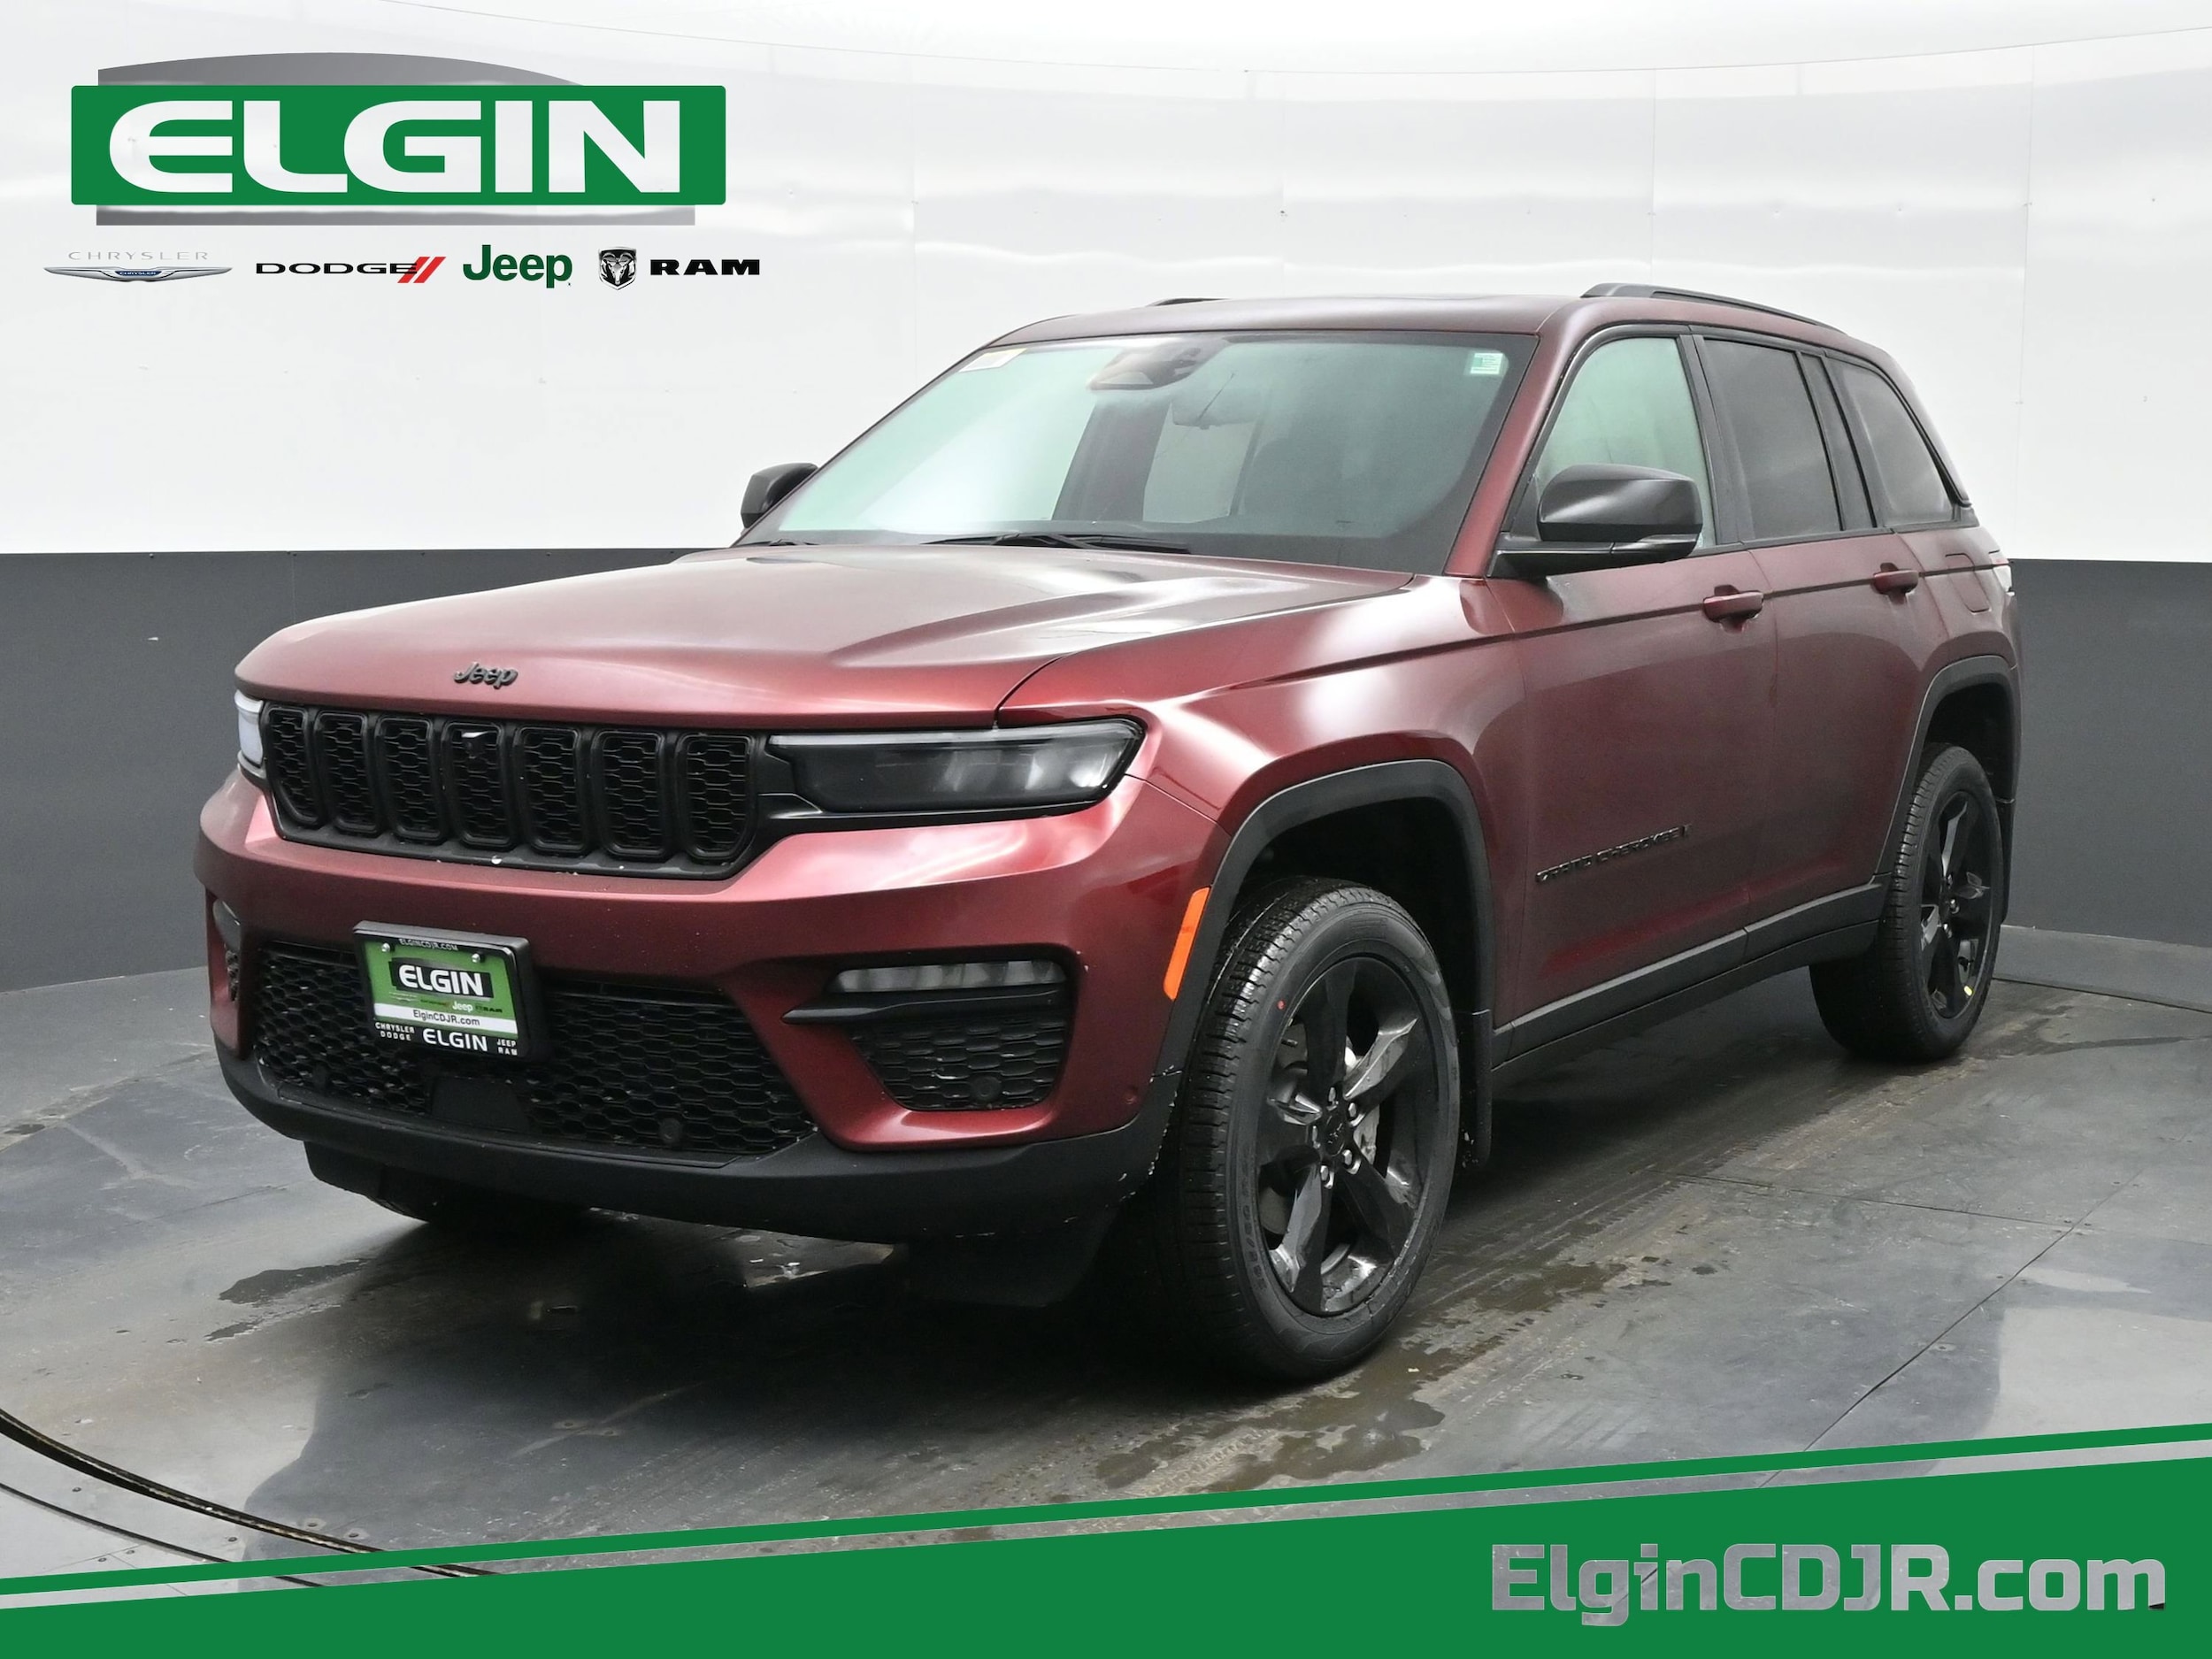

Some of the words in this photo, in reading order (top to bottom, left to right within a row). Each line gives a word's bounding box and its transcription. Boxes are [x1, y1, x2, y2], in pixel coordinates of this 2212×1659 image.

[454, 662, 518, 689] Jeep
[399, 964, 484, 996] ELGIN
[452, 1001, 473, 1013] Jeep
[413, 1010, 480, 1026] ElginCDJR.com
[375, 1022, 414, 1033] CHRYSLER
[380, 1031, 411, 1041] DODGE
[422, 1028, 488, 1052] ELGIN
[497, 1047, 518, 1056] RAM
